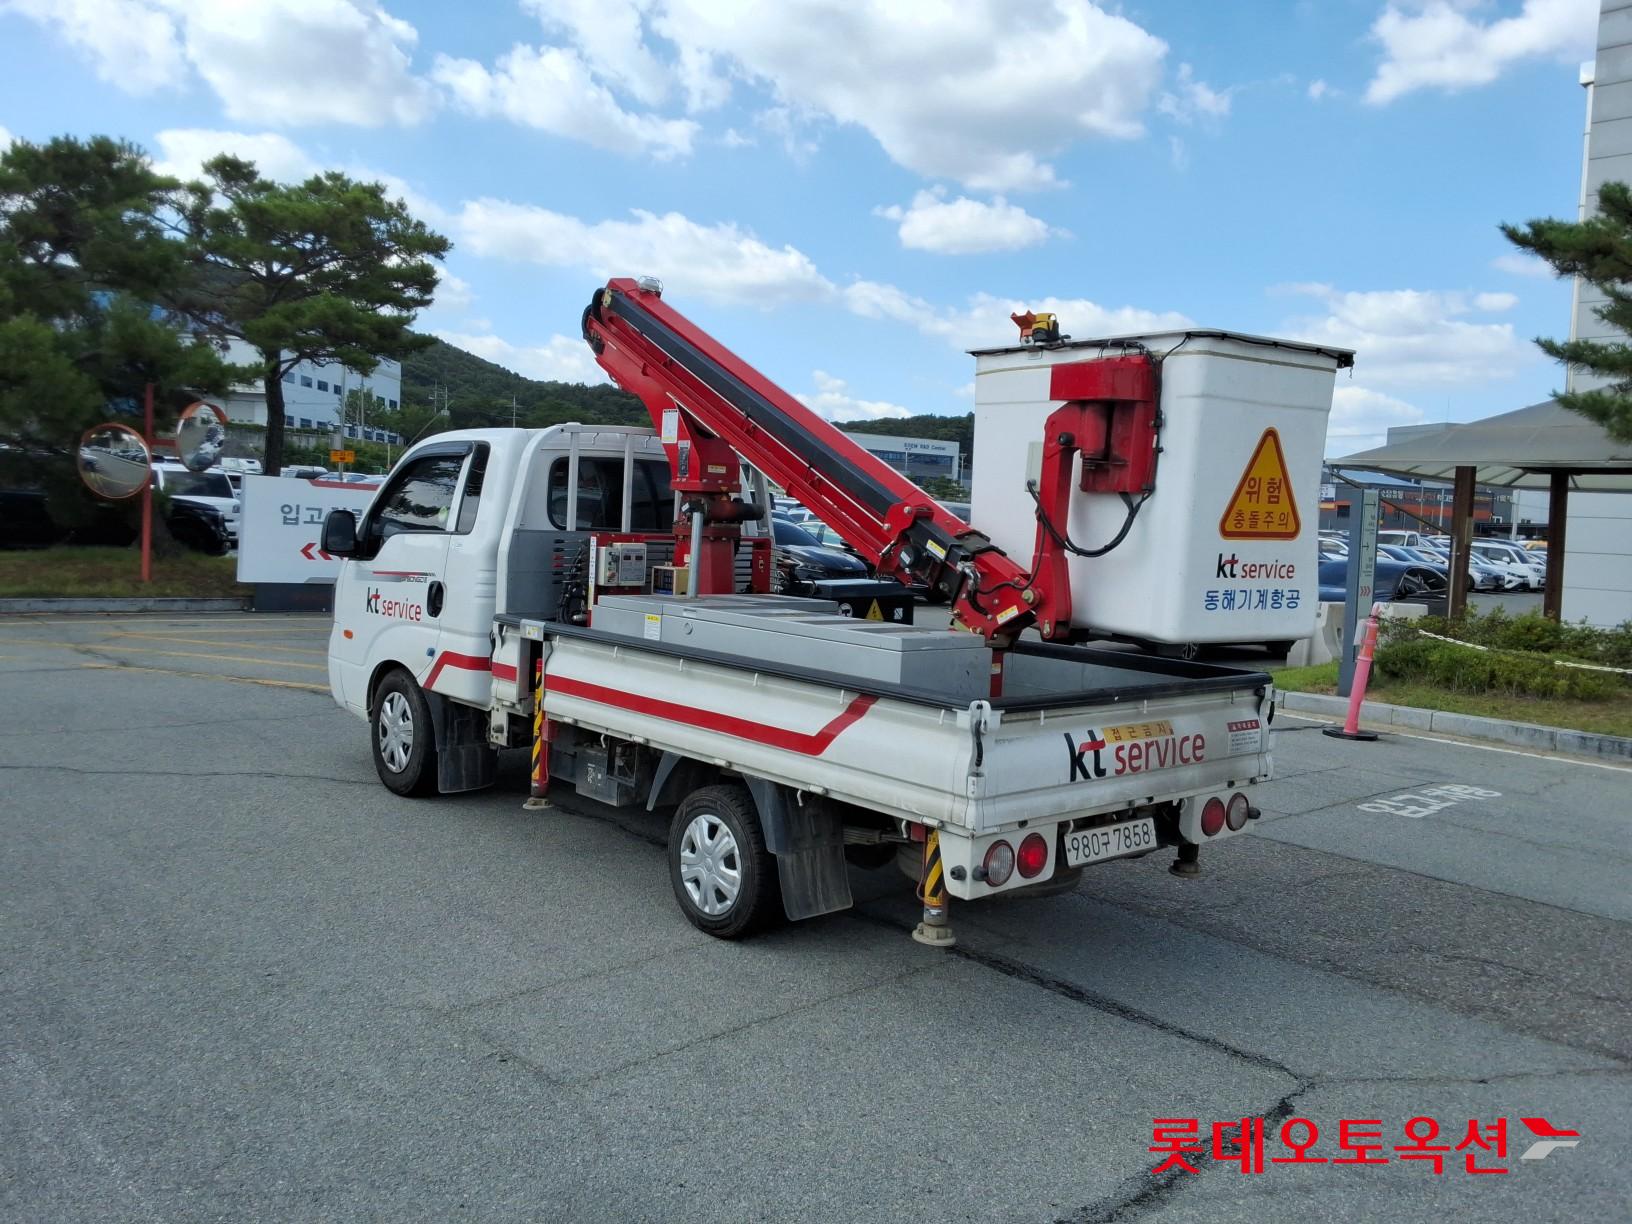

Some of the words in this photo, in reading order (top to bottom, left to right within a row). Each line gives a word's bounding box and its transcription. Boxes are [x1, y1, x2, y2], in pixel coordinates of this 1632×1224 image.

[1245, 476, 1282, 505] 위험
[281, 504, 326, 525] 입고
[1233, 509, 1289, 529] 충돌주의
[1216, 553, 1239, 579] kt
[1241, 559, 1295, 579] service
[366, 587, 380, 614] kt
[382, 597, 422, 621] service
[1204, 588, 1300, 611] 동해기계항공
[1064, 729, 1107, 783] kt
[1114, 733, 1206, 776] service
